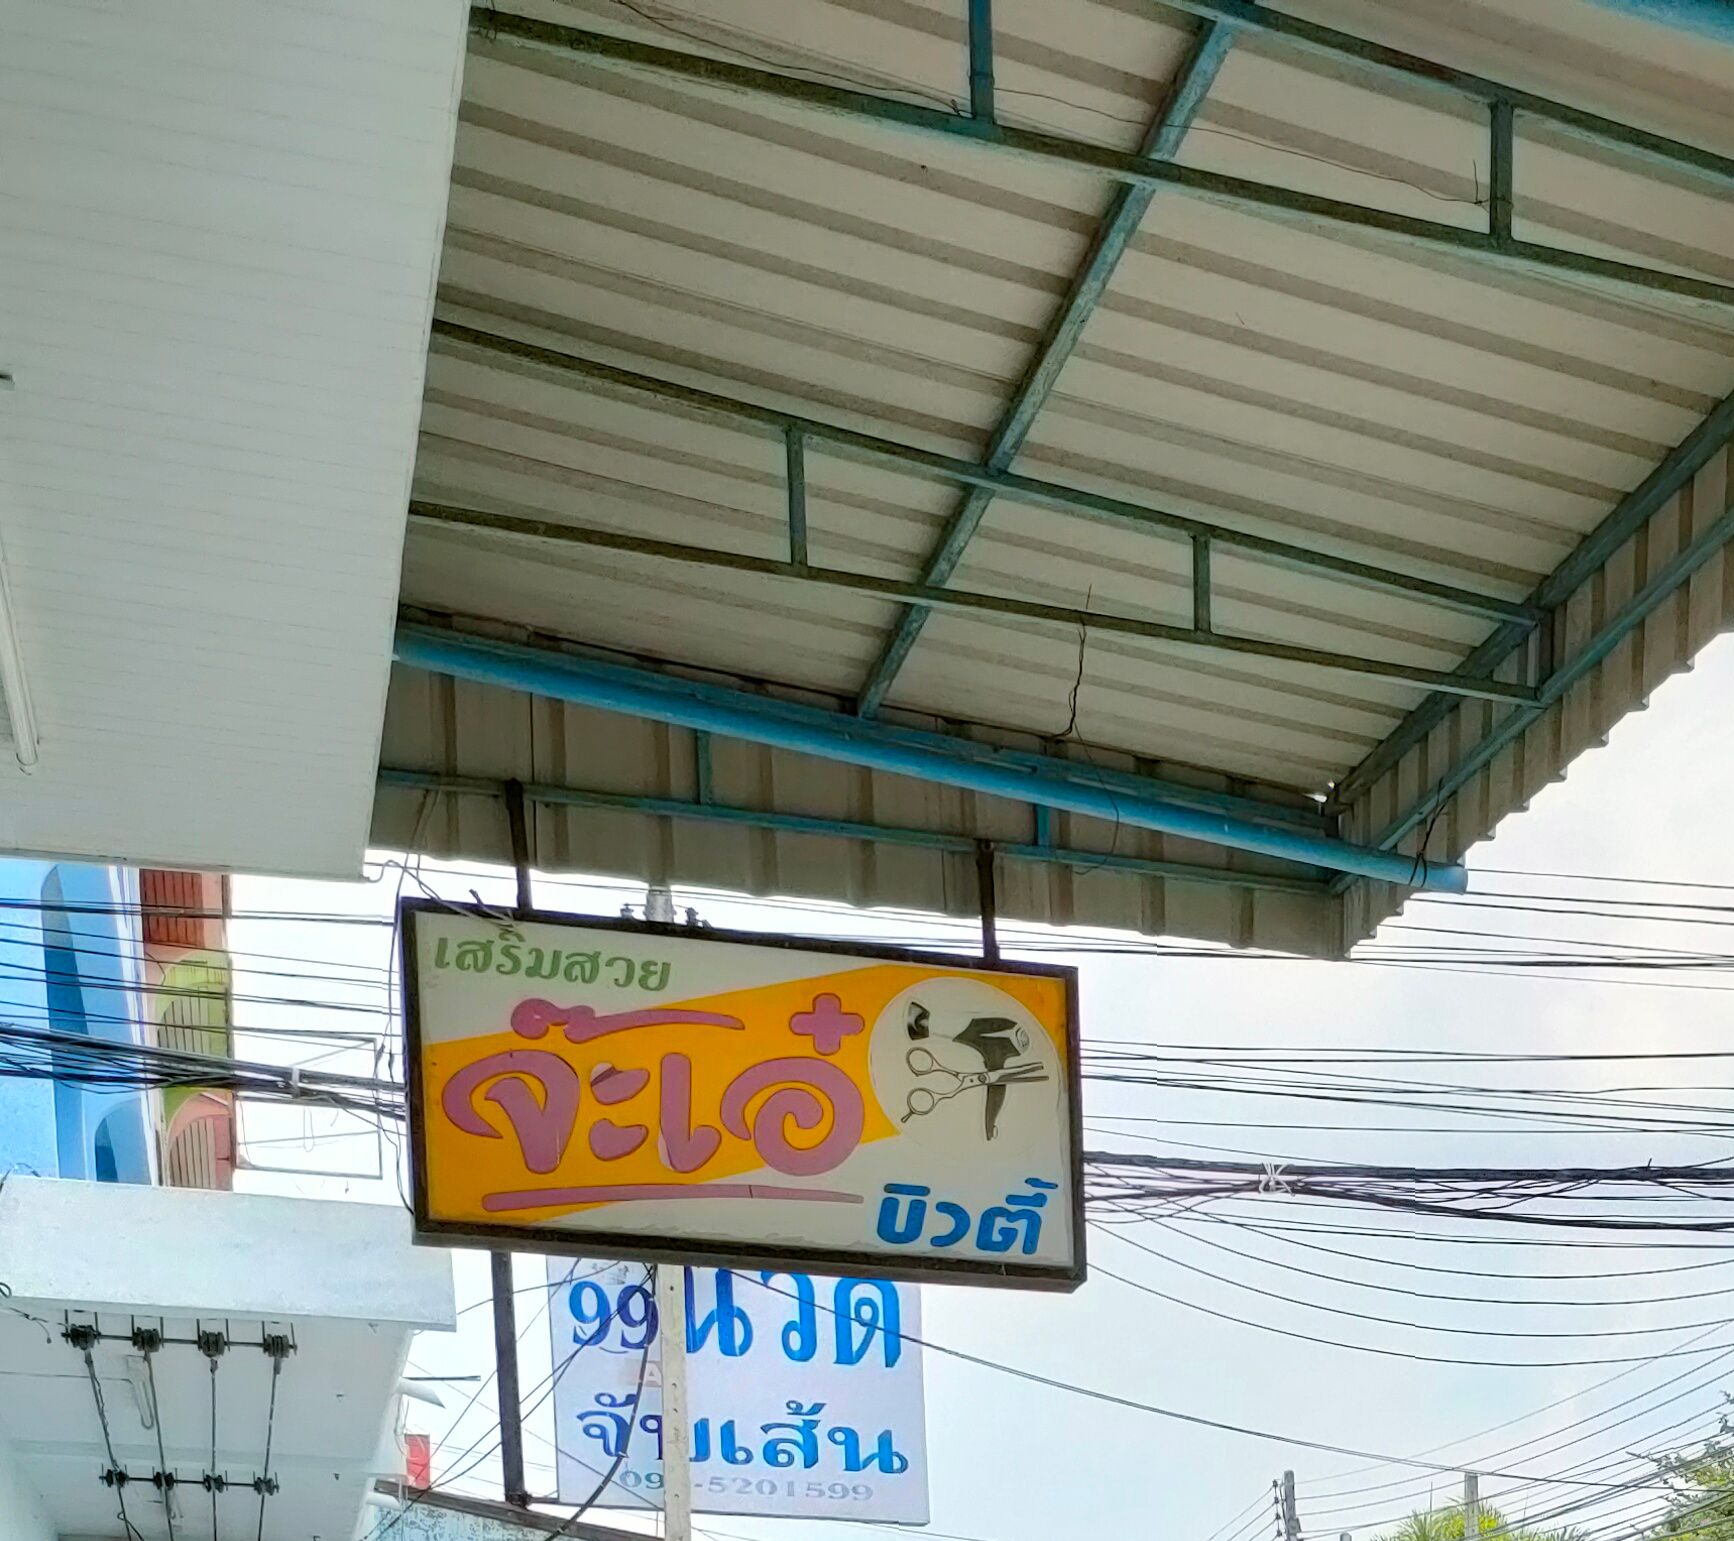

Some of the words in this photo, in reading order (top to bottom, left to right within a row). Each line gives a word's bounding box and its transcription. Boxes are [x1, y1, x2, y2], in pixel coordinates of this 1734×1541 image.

[434, 930, 672, 993] เสริมสวย
[441, 992, 866, 1177] จ๊ะเอ๋
[876, 1176, 1059, 1256] บิวตี้
[618, 1470, 875, 1501] 09-5201599
